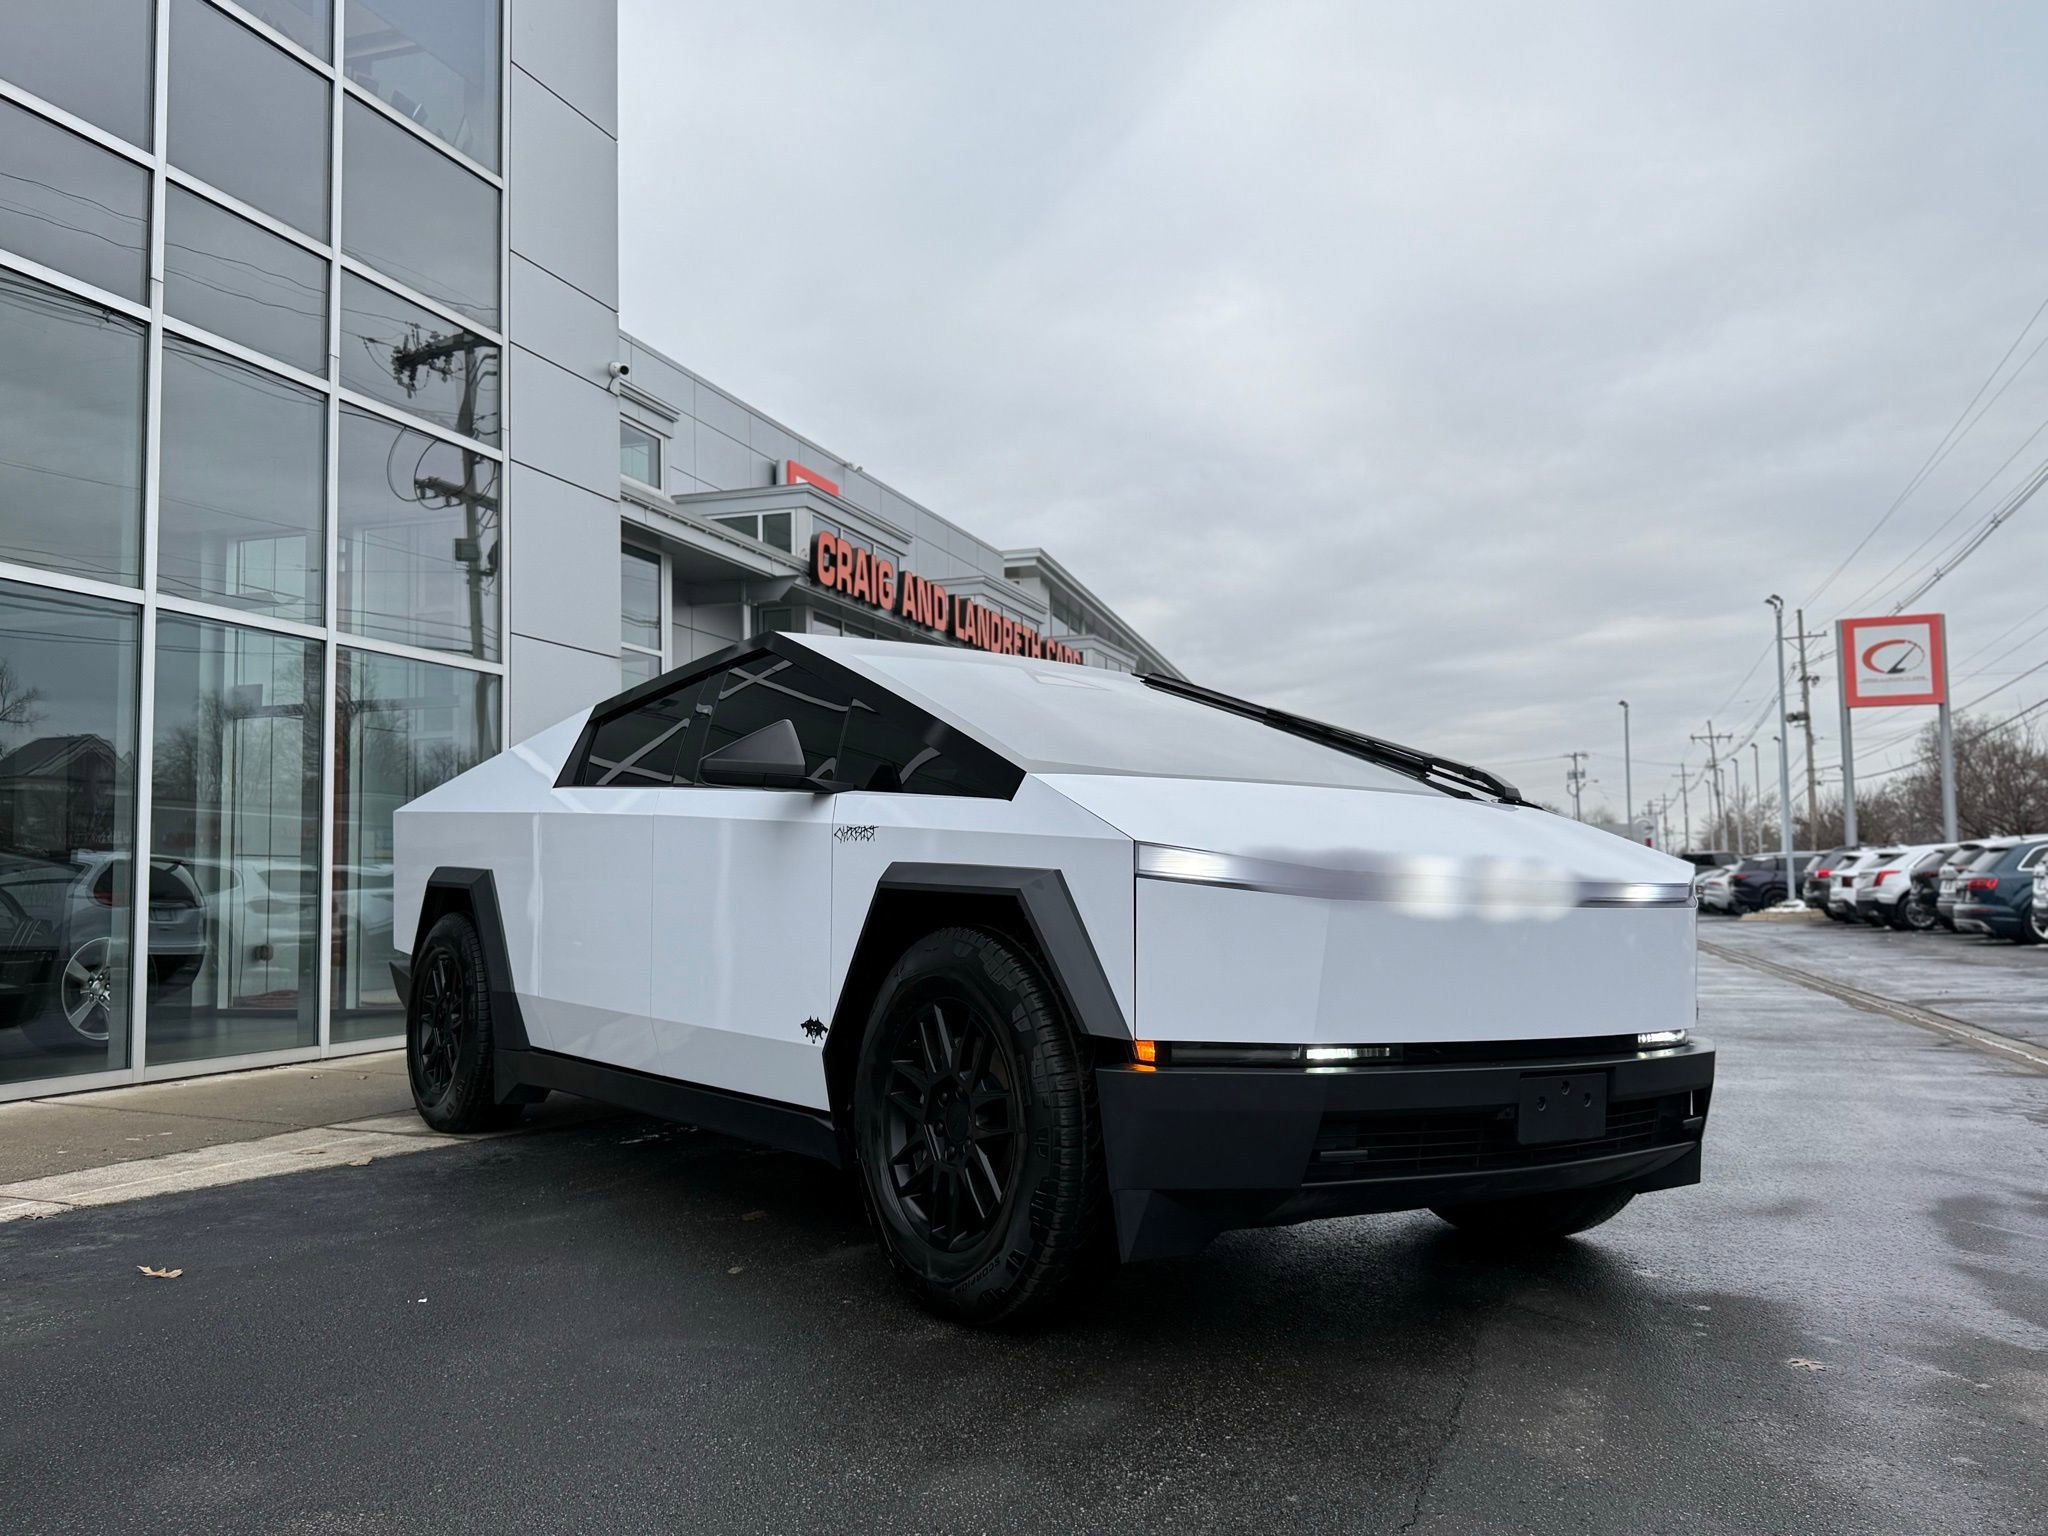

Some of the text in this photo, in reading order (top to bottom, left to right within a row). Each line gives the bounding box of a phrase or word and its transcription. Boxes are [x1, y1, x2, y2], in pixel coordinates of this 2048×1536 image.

[816, 530, 894, 611] CRAIG
[902, 570, 947, 632] AND
[954, 593, 1041, 659] LANDRETH
